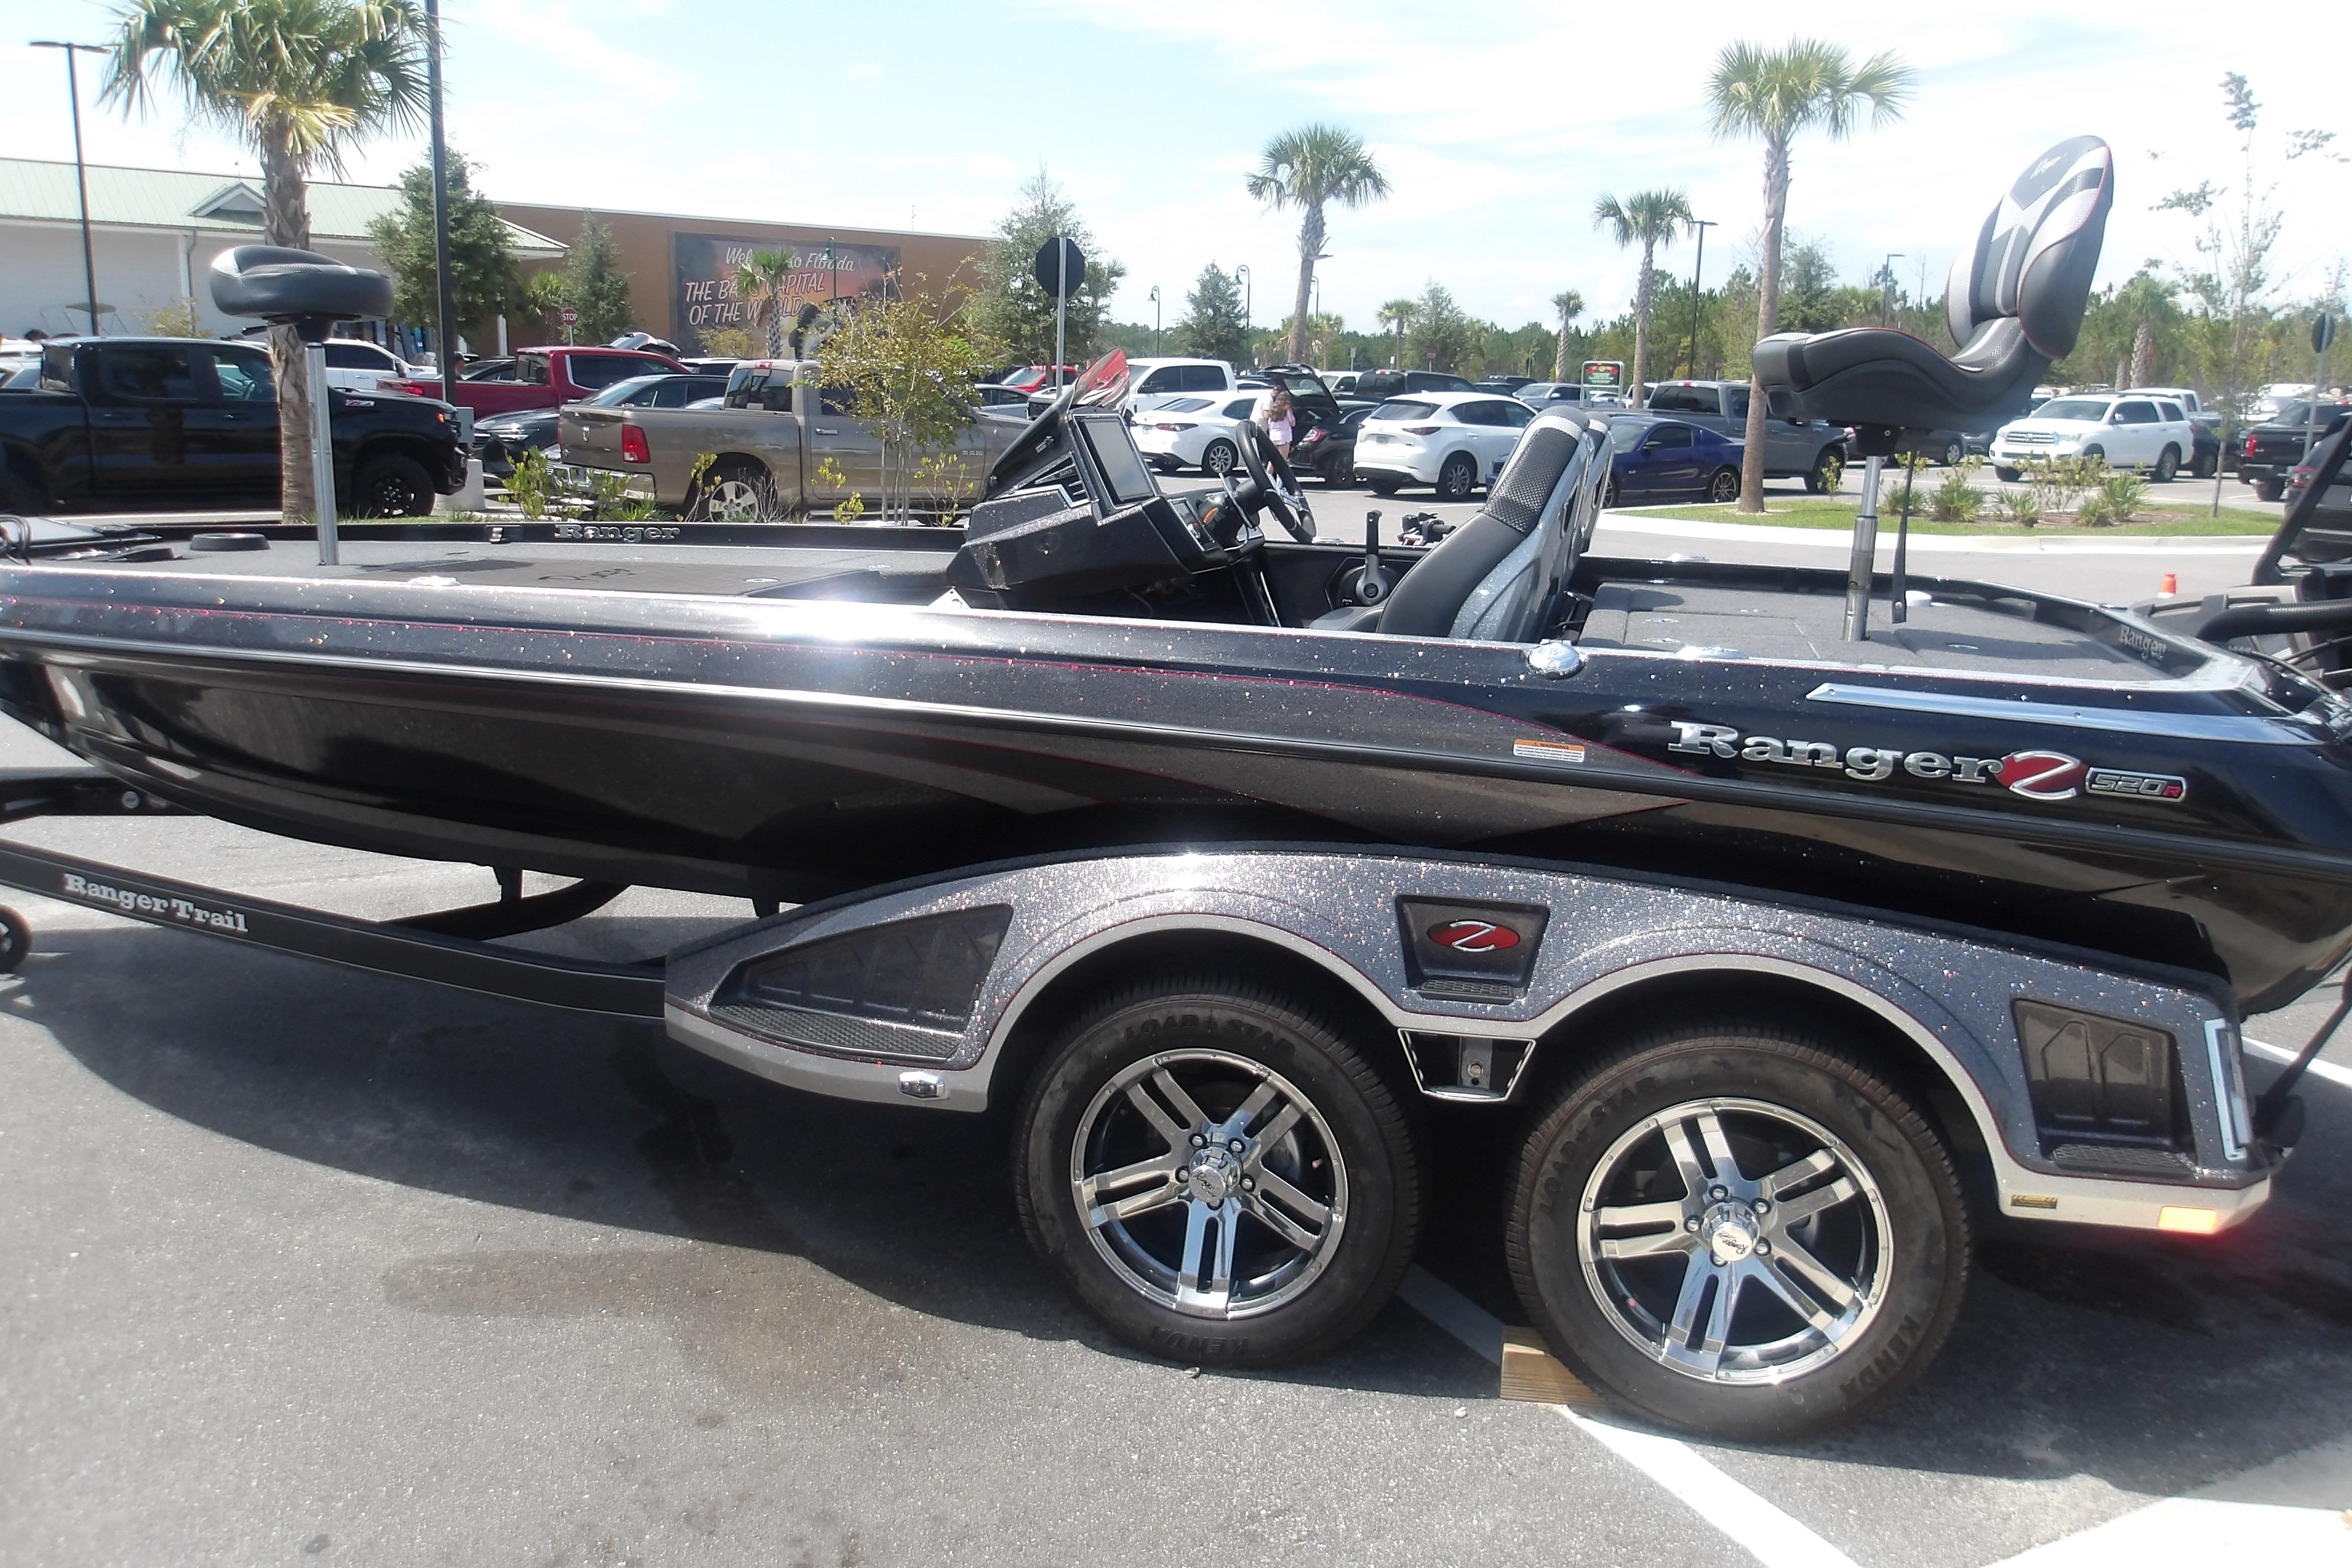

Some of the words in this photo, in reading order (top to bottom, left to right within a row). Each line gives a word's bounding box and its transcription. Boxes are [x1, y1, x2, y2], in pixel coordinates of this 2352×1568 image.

[685, 280, 716, 303] THE
[718, 279, 759, 300] BAS
[689, 304, 713, 326] OF
[714, 301, 744, 324] THE
[747, 297, 803, 321] WLD
[554, 524, 681, 543] Ranger
[2118, 624, 2167, 660] Ranger
[1668, 720, 2004, 783] Ranger
[64, 873, 169, 911] Ranger
[171, 898, 249, 933] Trail
